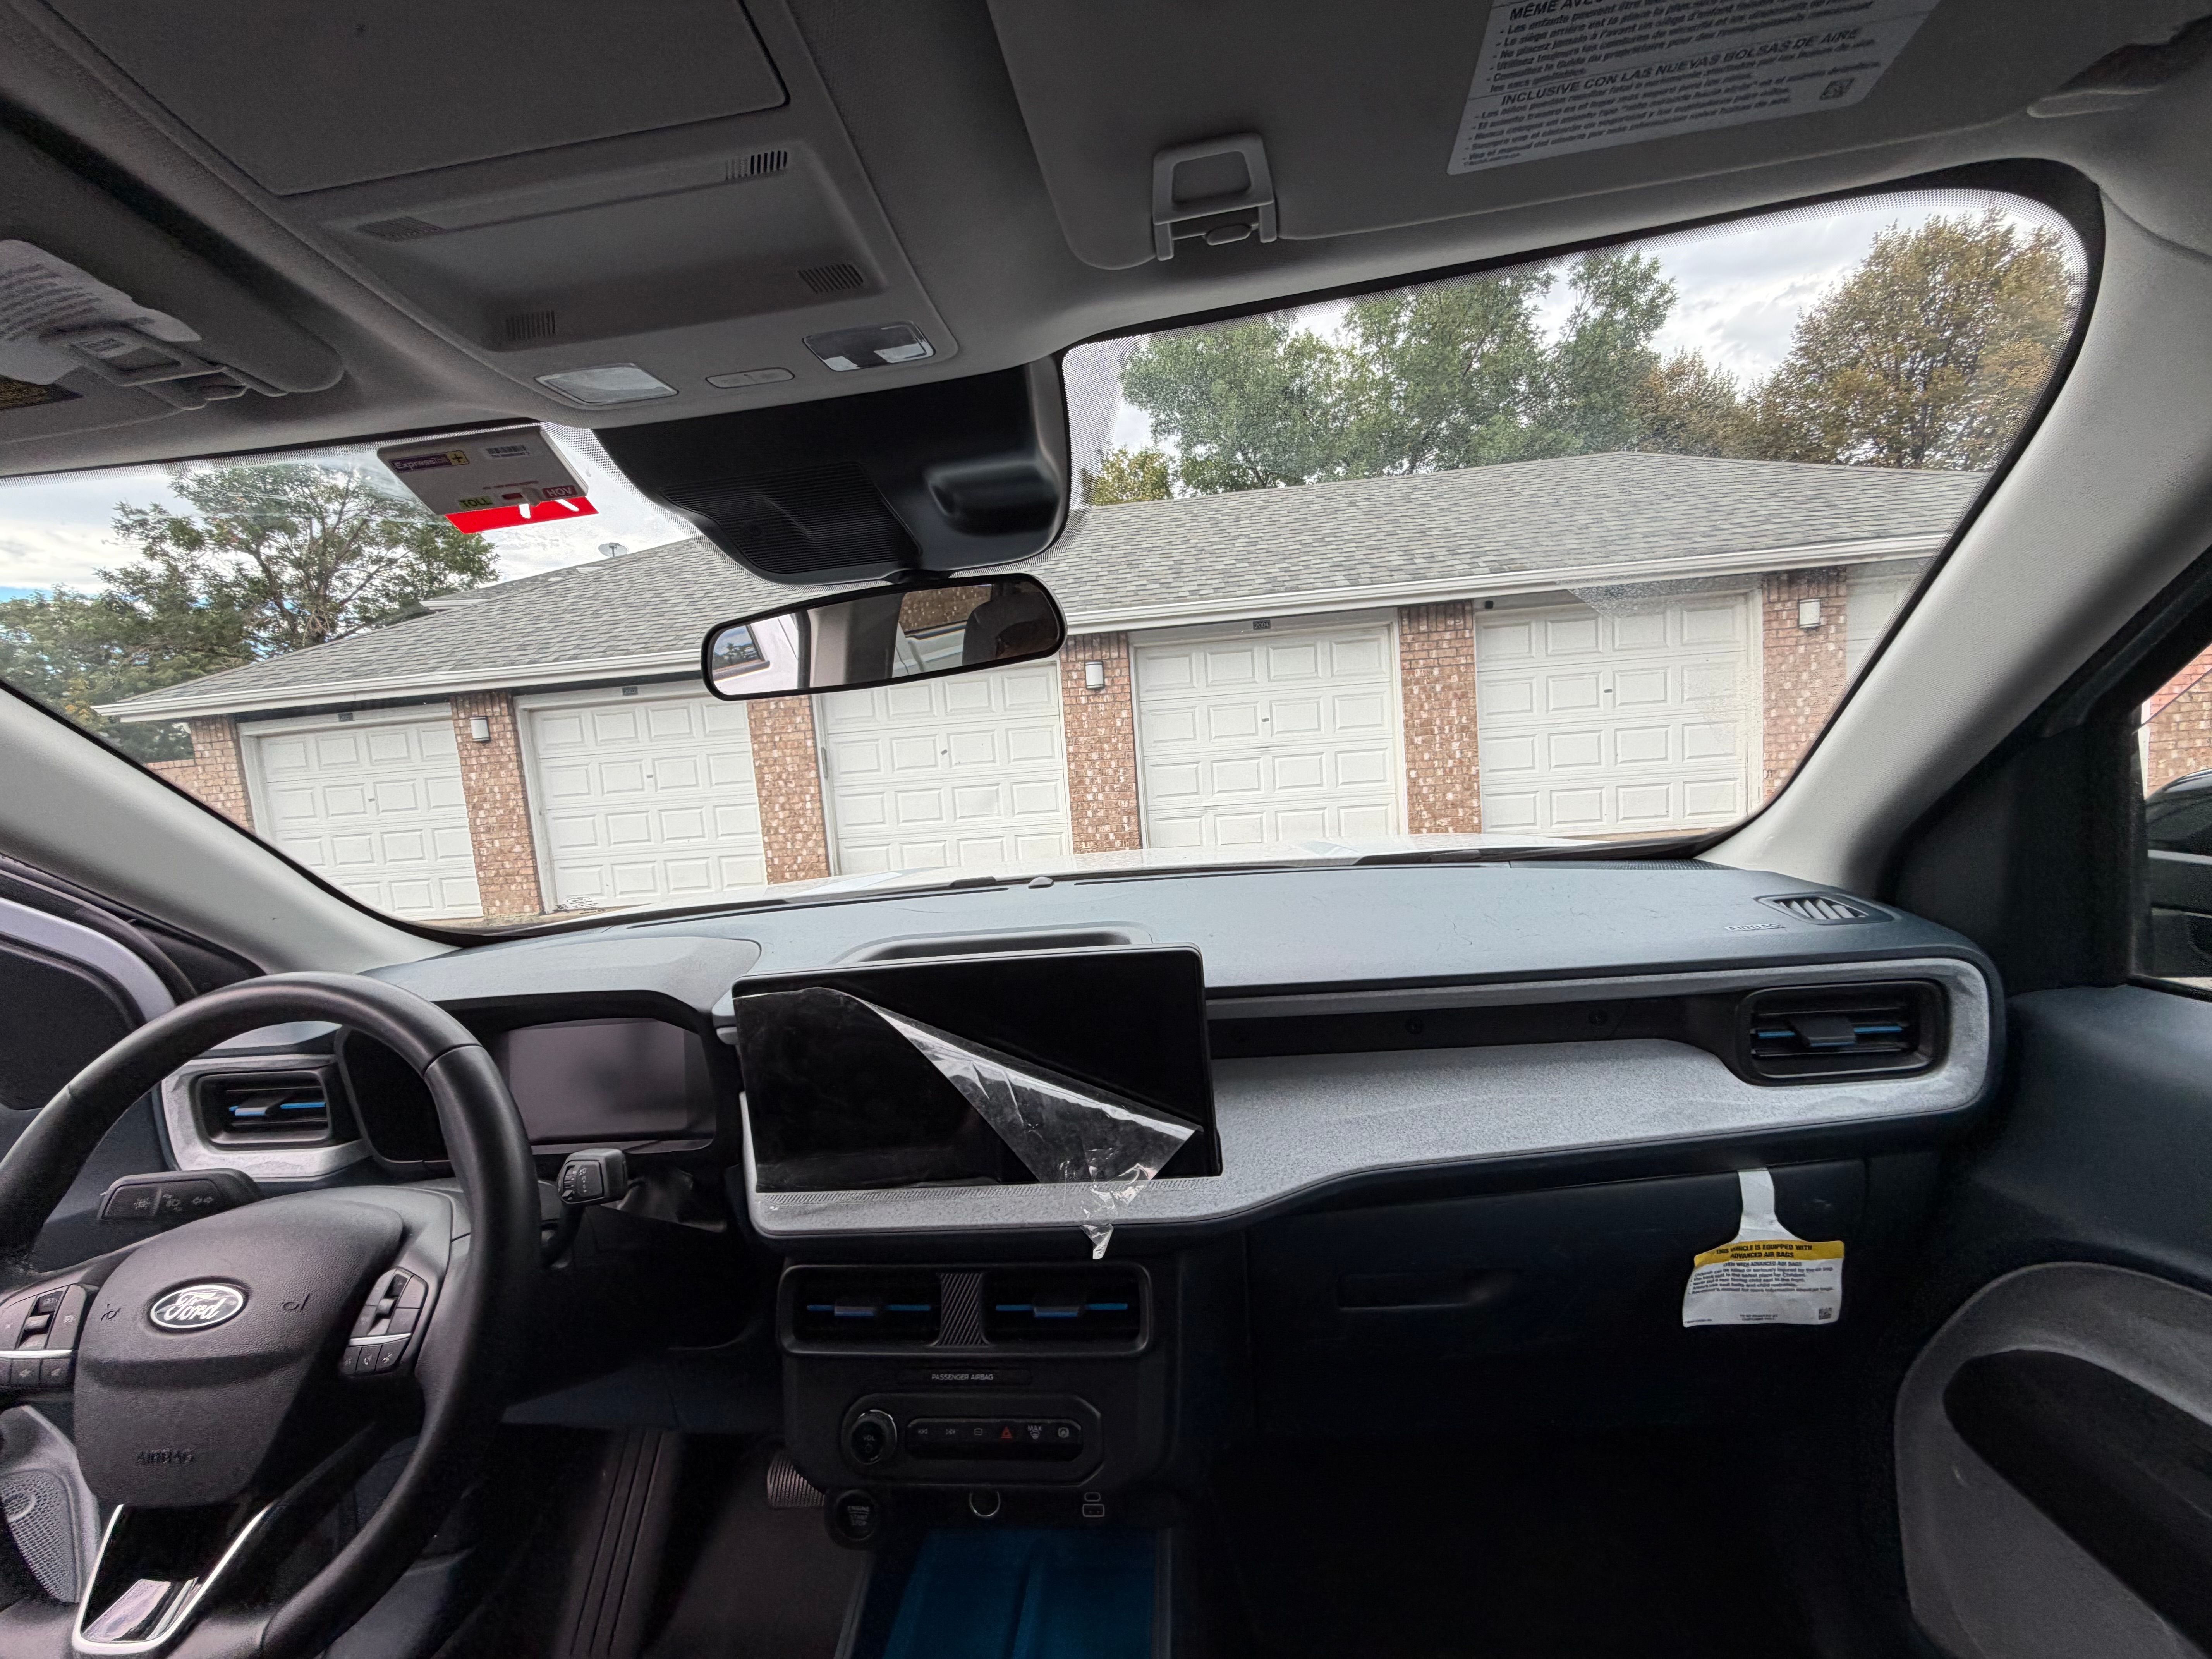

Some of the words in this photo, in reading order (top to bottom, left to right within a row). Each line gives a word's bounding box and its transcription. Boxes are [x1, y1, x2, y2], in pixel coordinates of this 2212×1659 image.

[1501, 81, 1580, 105] INCLUSIVE
[1583, 74, 1618, 88] CON
[1621, 67, 1652, 81] LAS
[1656, 54, 1720, 75] NUEVAS
[1723, 41, 1790, 62] BOLSAS
[1793, 37, 1814, 48] DE
[1822, 29, 1859, 43] AIRE
[394, 456, 450, 471] ExpressT
[546, 487, 573, 498] HOV
[459, 497, 493, 507] TOLL
[164, 1291, 228, 1321] Ford
